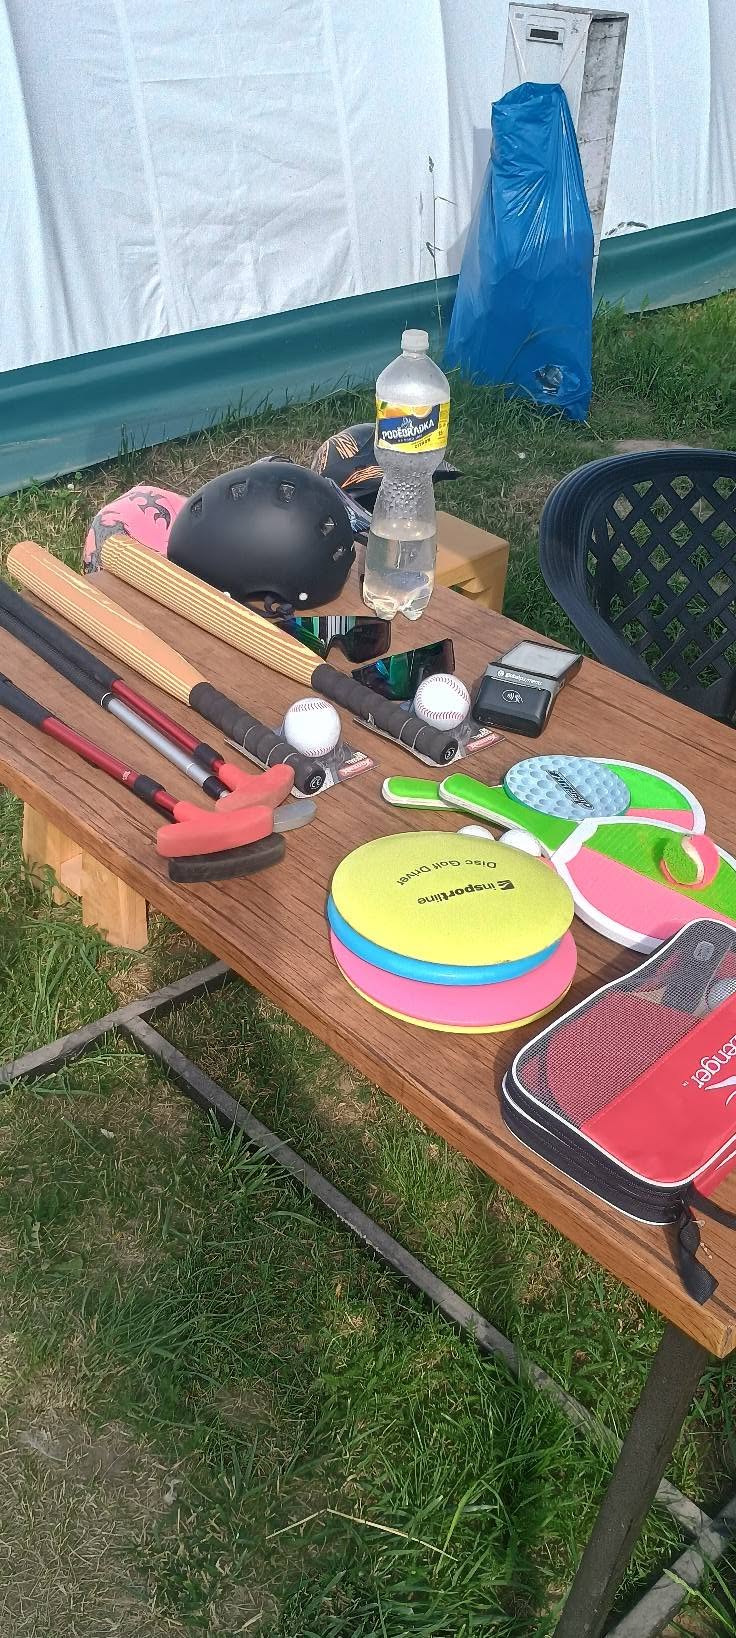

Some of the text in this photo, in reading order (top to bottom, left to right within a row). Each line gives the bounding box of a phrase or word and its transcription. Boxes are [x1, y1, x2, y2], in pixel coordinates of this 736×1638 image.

[396, 859, 497, 886] Disc Golf Driver
[417, 882, 497, 905] insportline
